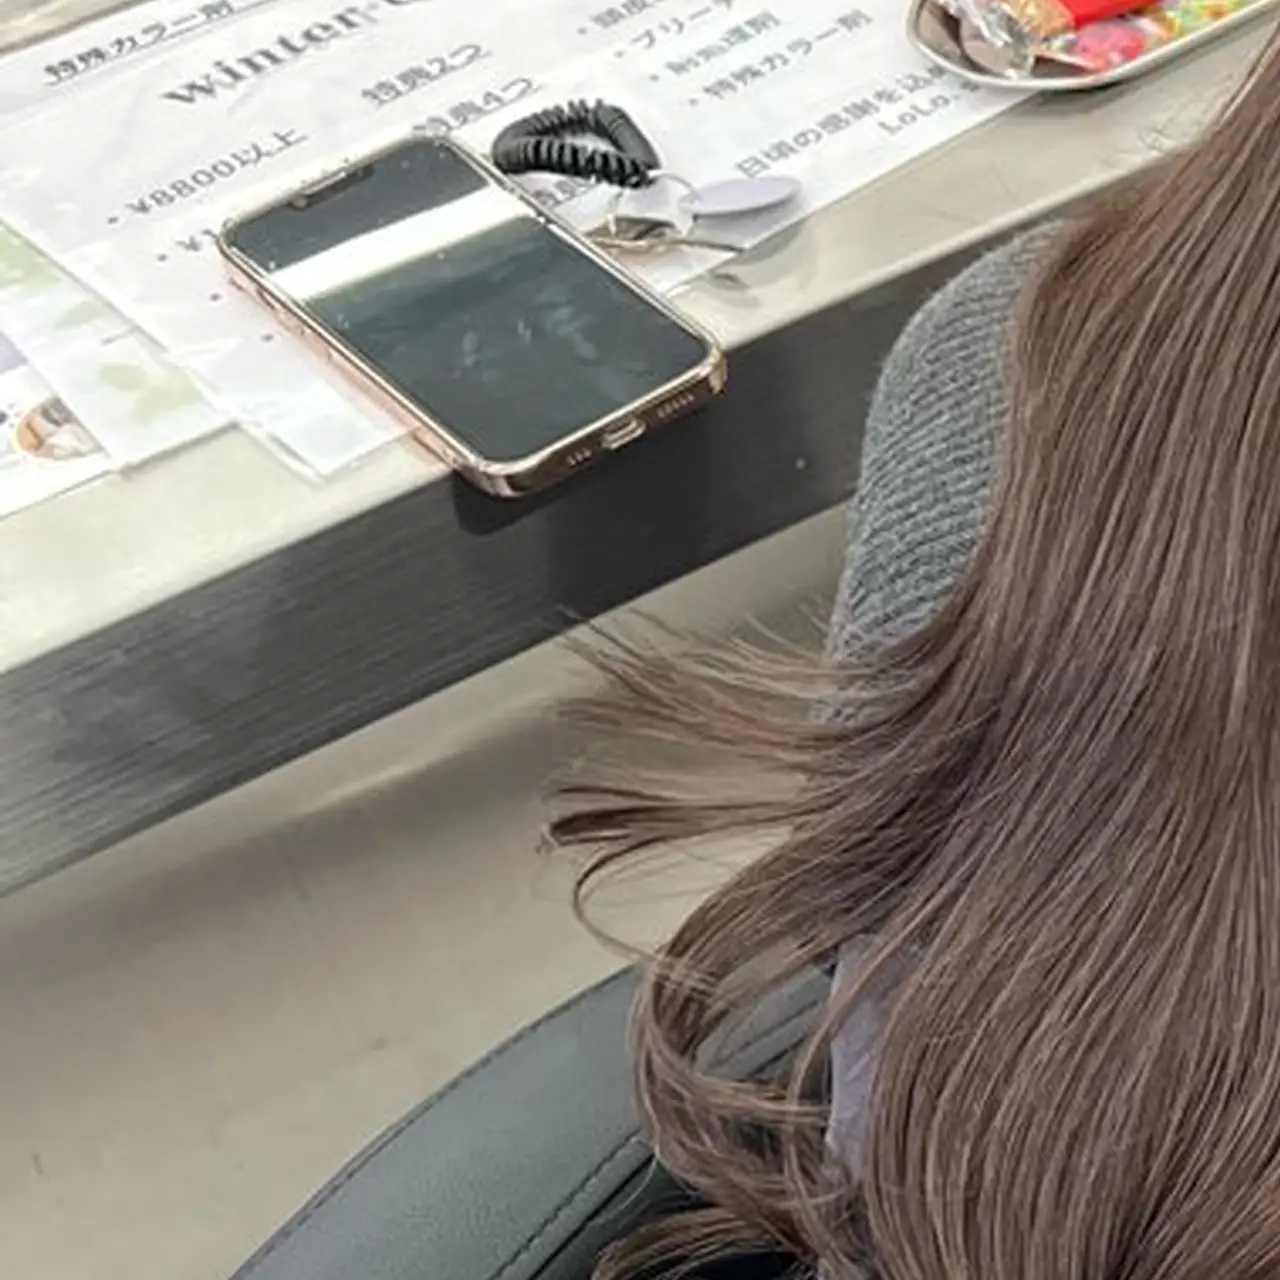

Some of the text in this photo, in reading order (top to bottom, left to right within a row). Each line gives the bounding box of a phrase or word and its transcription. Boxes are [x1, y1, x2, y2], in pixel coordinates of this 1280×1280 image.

[162, 5, 370, 106] winter
[360, 43, 488, 105] 特典2つ
[126, 127, 309, 215] ¥8800以上
